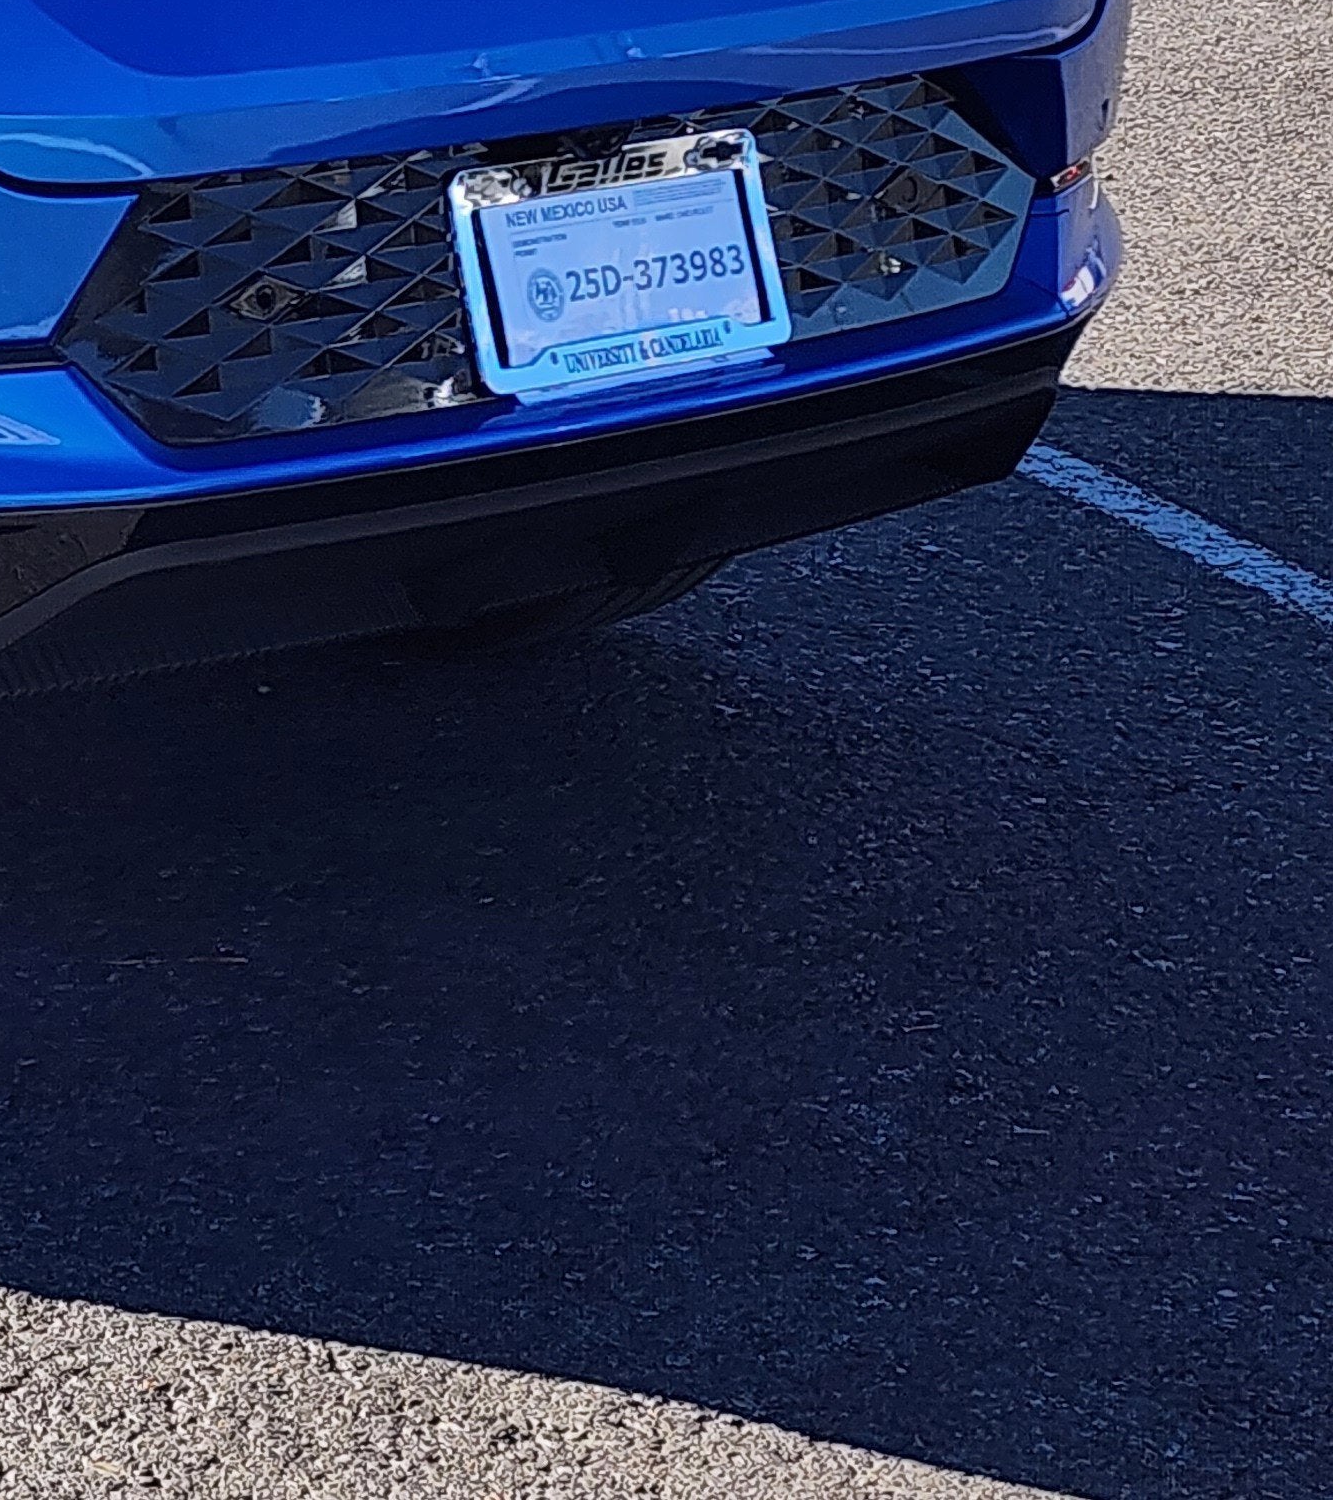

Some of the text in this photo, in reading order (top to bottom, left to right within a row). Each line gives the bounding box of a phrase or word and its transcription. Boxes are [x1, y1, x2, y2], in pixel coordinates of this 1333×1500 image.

[505, 194, 628, 228] NEW MEXICO USA
[564, 243, 746, 303] 25D-373983
